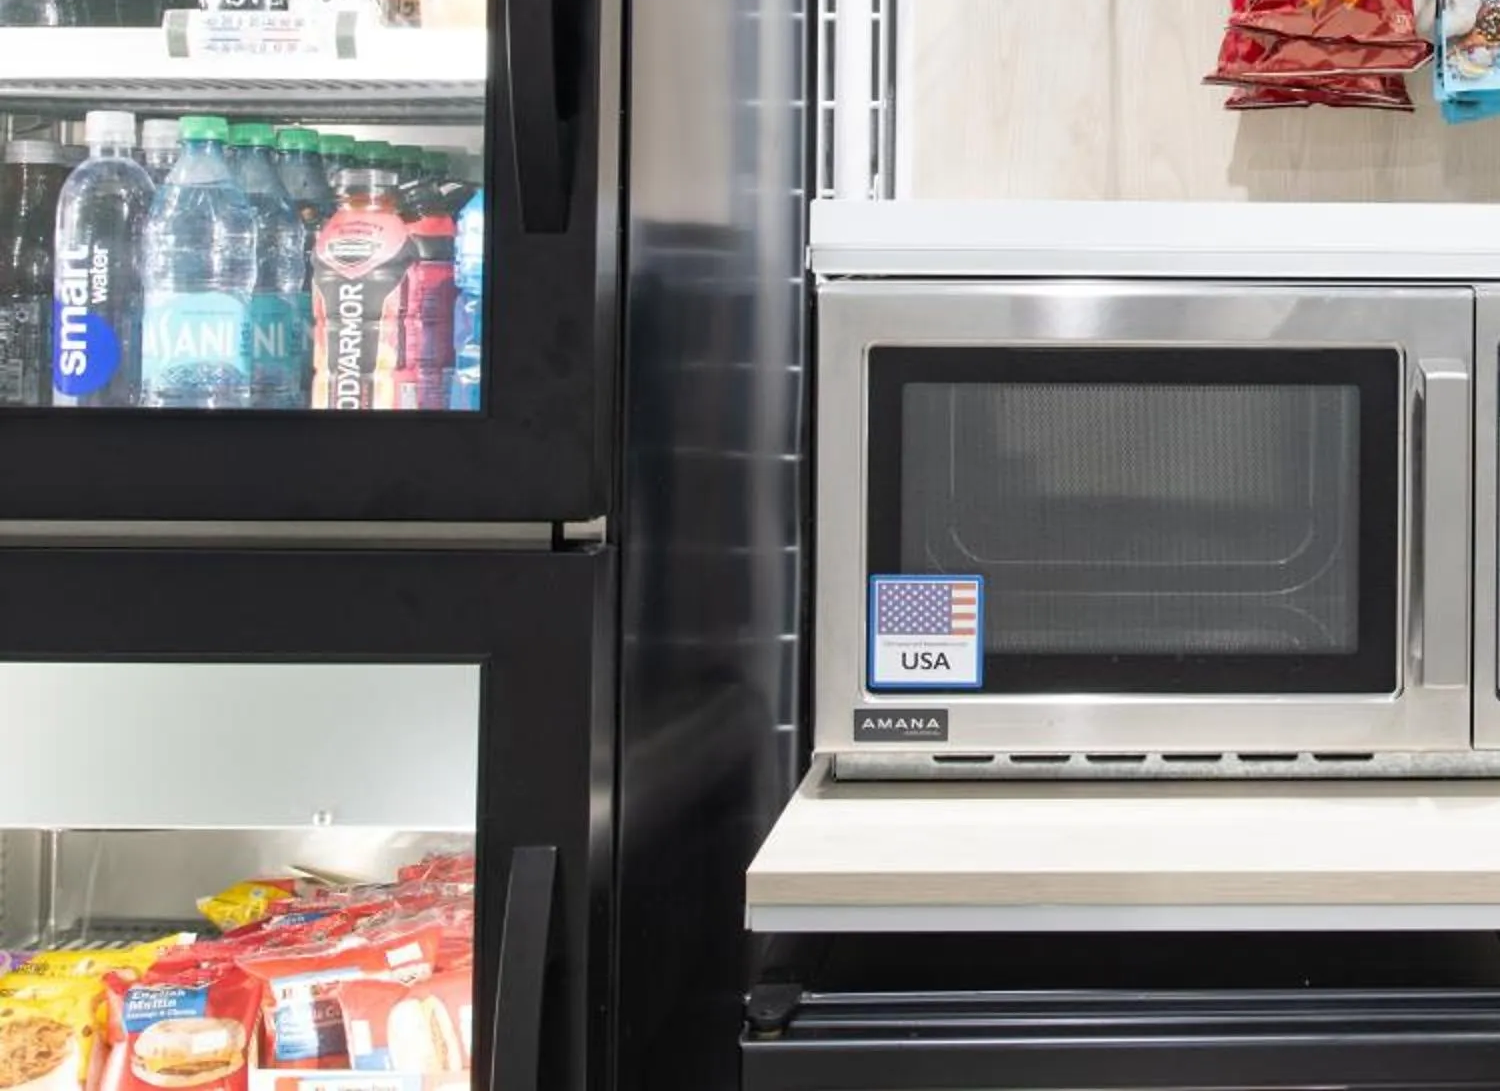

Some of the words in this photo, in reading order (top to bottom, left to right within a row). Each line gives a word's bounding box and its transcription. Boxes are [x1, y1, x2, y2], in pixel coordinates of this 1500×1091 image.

[91, 245, 109, 305] water
[58, 242, 88, 378] smart
[337, 283, 364, 408] ODYARMOR
[901, 652, 951, 670] USA
[861, 717, 941, 730] AMANA
[129, 998, 177, 1010] Muffin
[130, 989, 187, 1001] English
